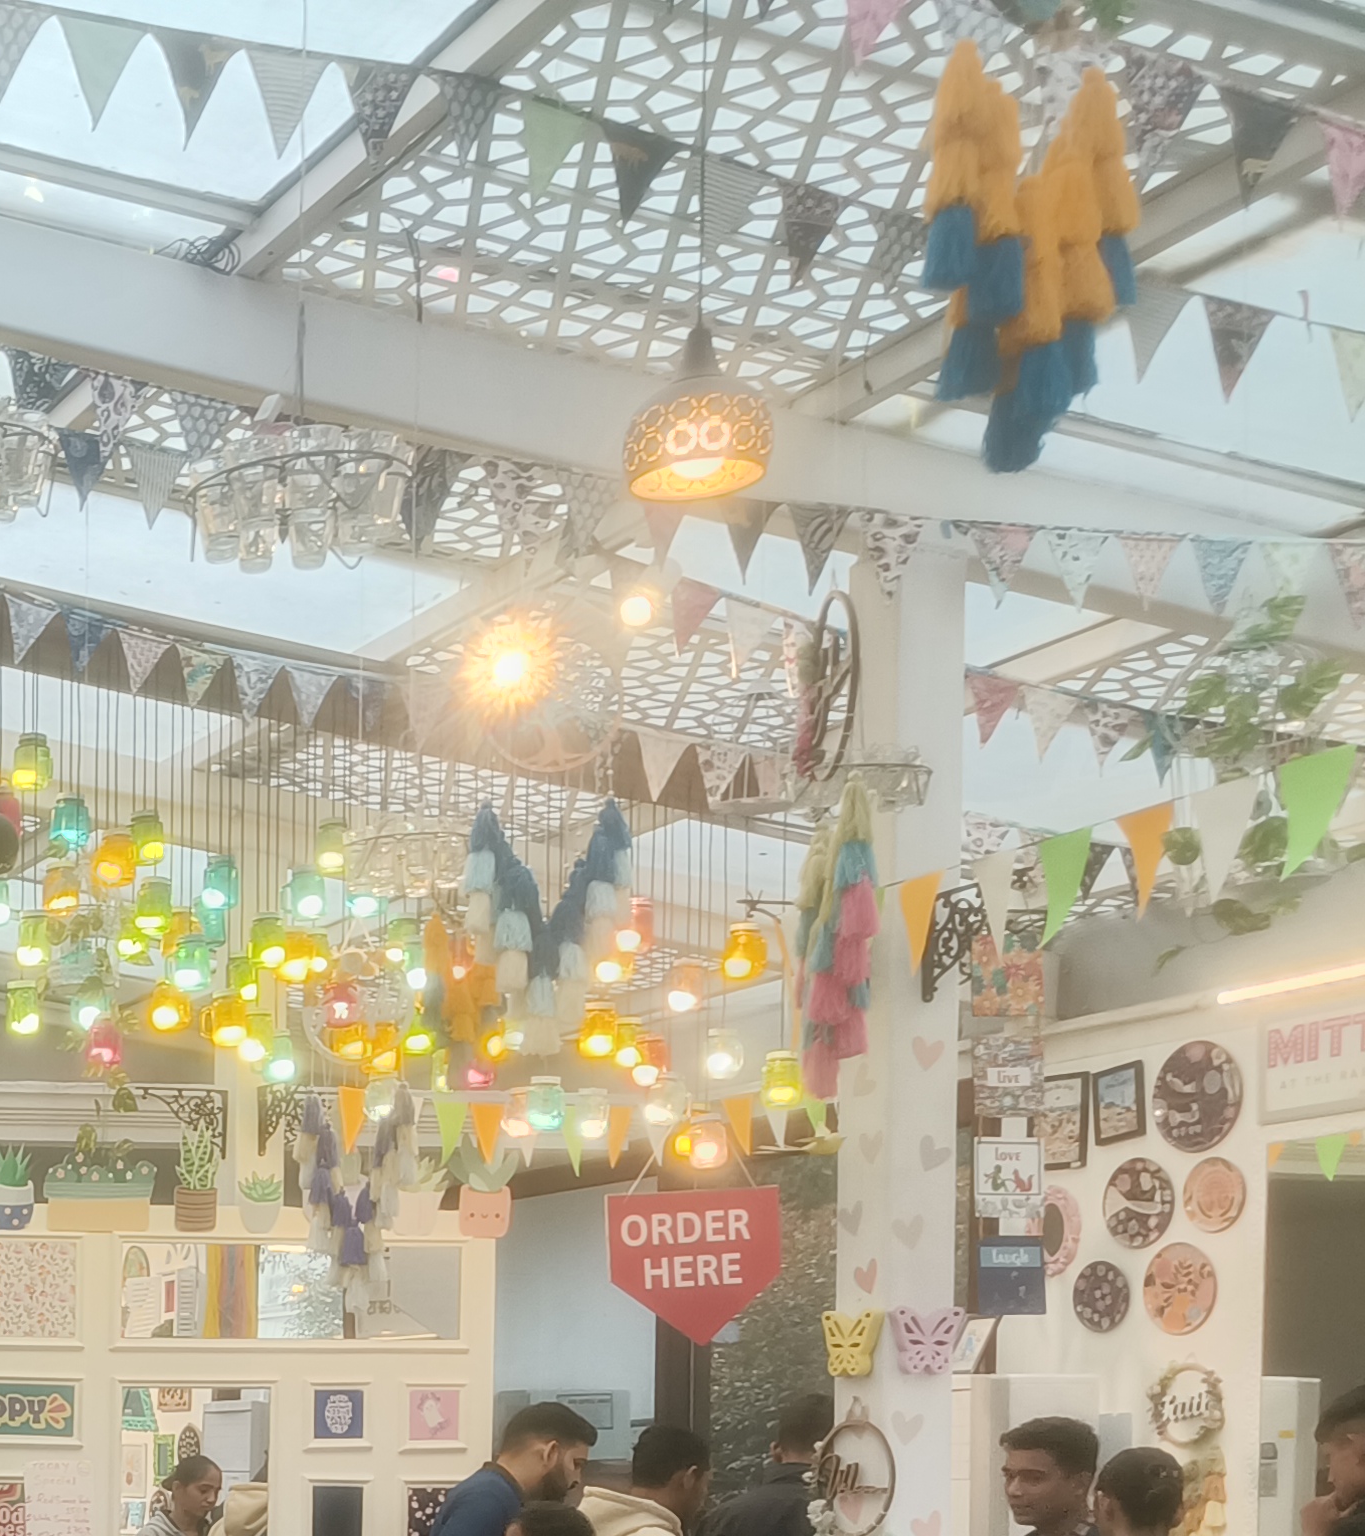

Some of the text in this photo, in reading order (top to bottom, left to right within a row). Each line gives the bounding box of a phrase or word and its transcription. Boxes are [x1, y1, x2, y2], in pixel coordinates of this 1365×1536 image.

[1280, 1079, 1297, 1089] AT
[620, 1209, 751, 1247] ORDER
[642, 1252, 744, 1291] HERE
